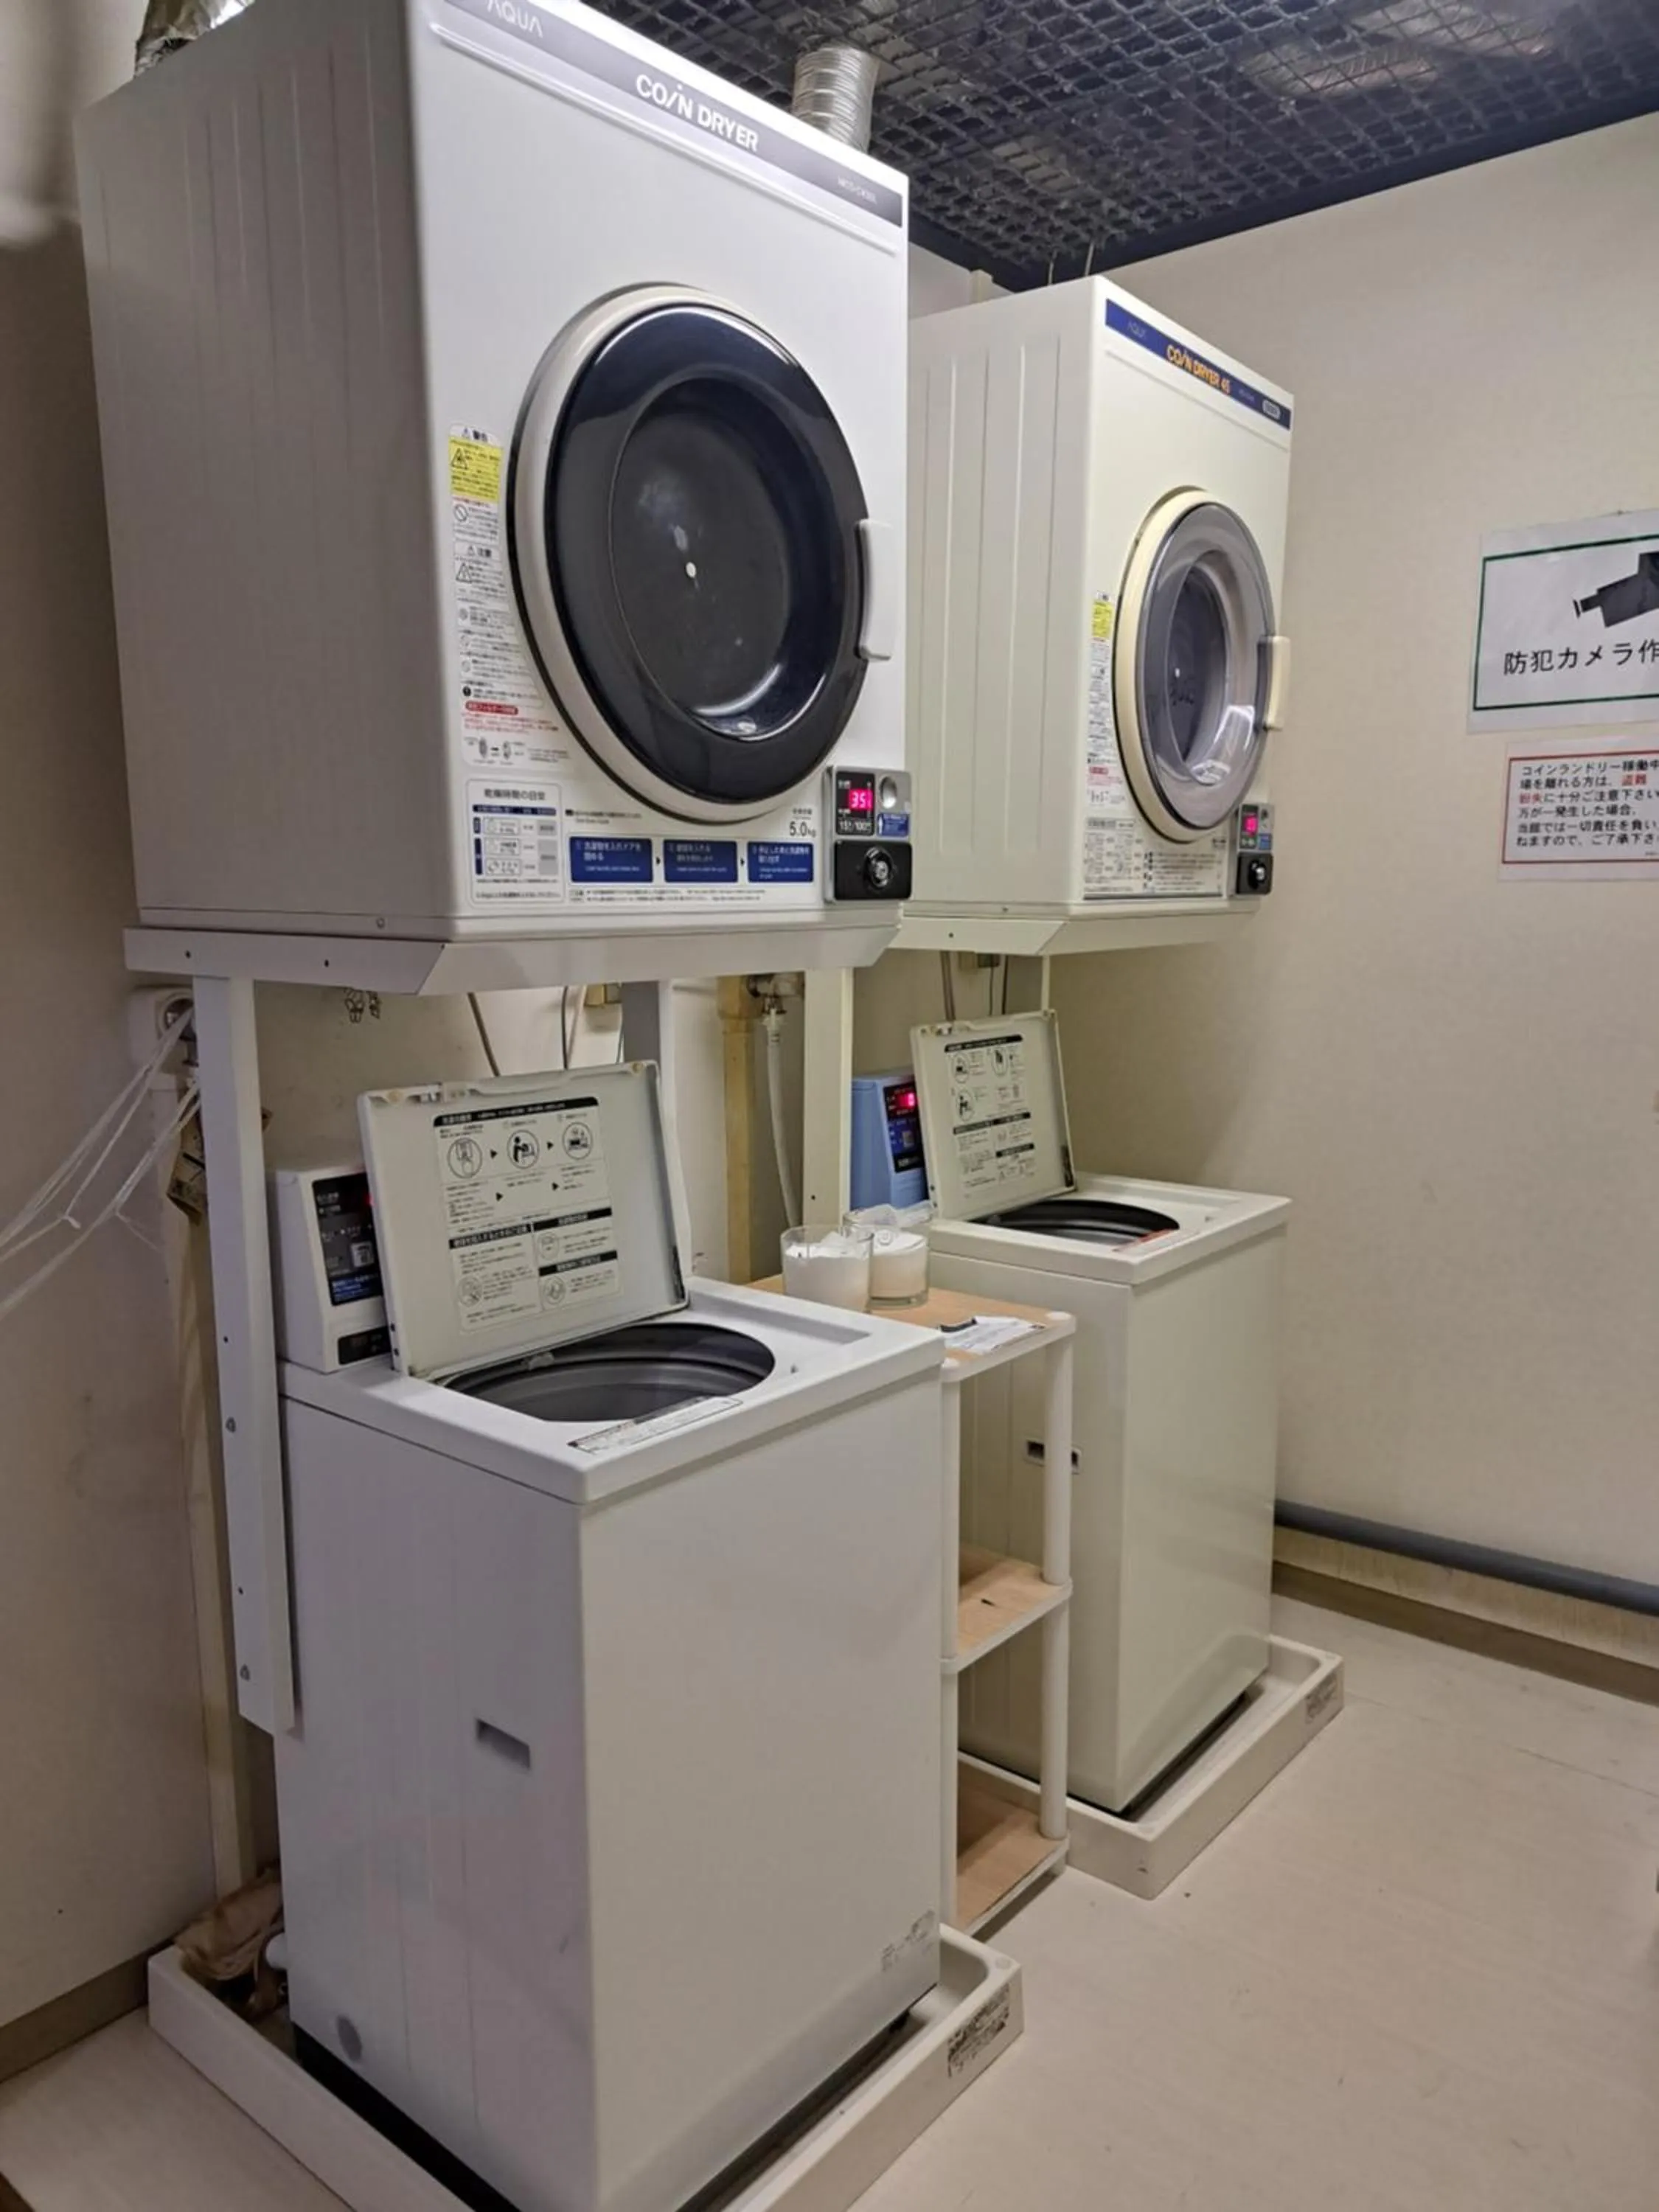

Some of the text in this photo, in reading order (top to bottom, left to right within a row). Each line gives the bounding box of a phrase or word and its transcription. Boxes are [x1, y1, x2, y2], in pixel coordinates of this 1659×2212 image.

[698, 103, 759, 152] DRYER
[1503, 639, 1659, 676] 防犯カメラ作
